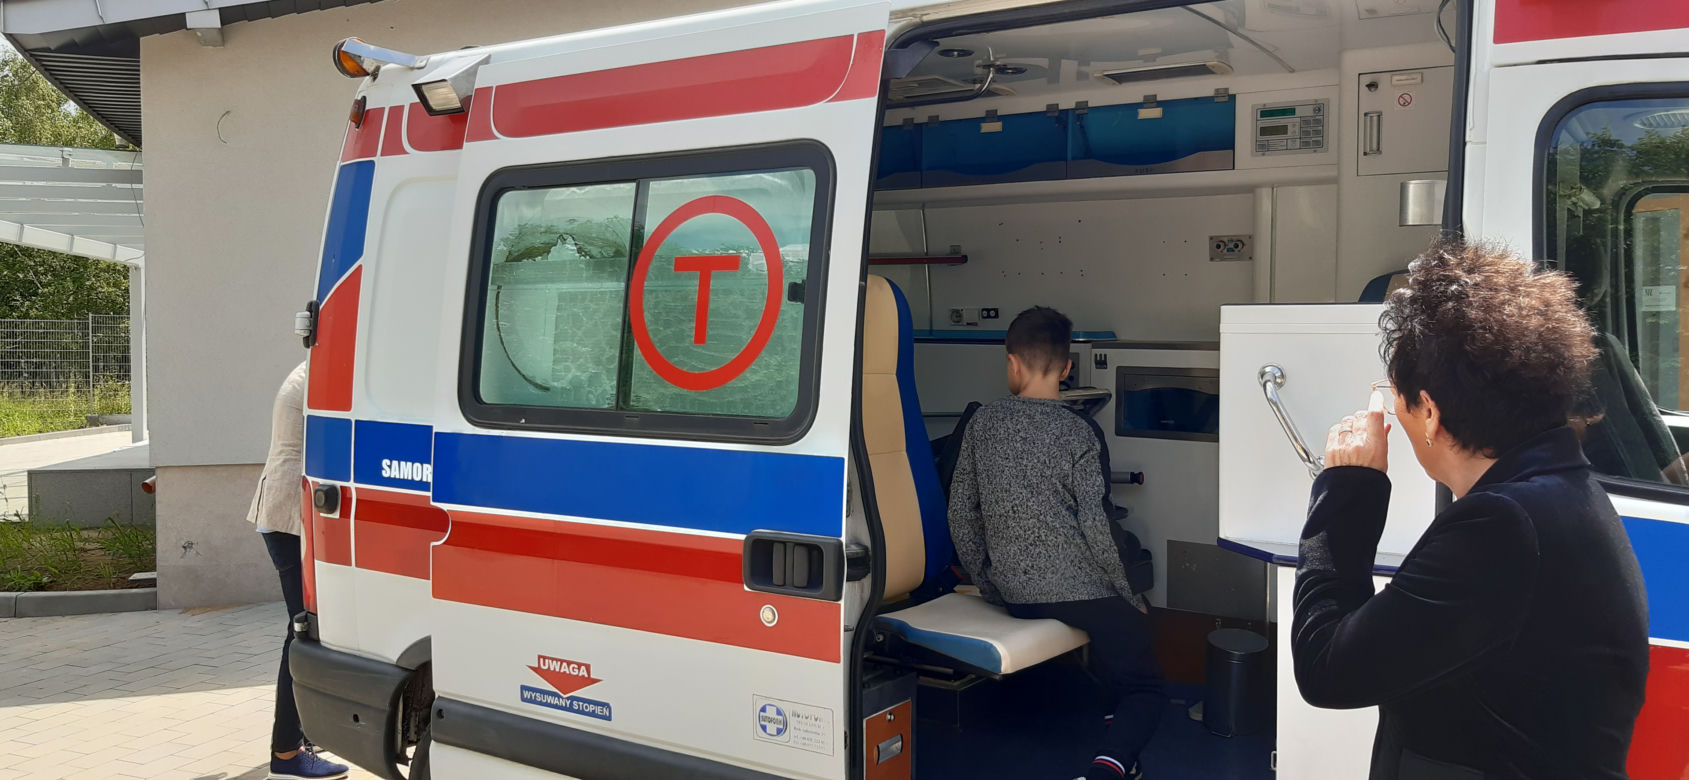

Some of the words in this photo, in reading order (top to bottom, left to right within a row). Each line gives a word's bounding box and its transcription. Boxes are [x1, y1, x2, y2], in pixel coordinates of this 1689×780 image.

[674, 255, 741, 345] T
[382, 459, 432, 482] SAMOR
[539, 658, 588, 678] UWAGA
[523, 690, 571, 708] WYSUWANY
[572, 701, 610, 717] STOPIEŃ
